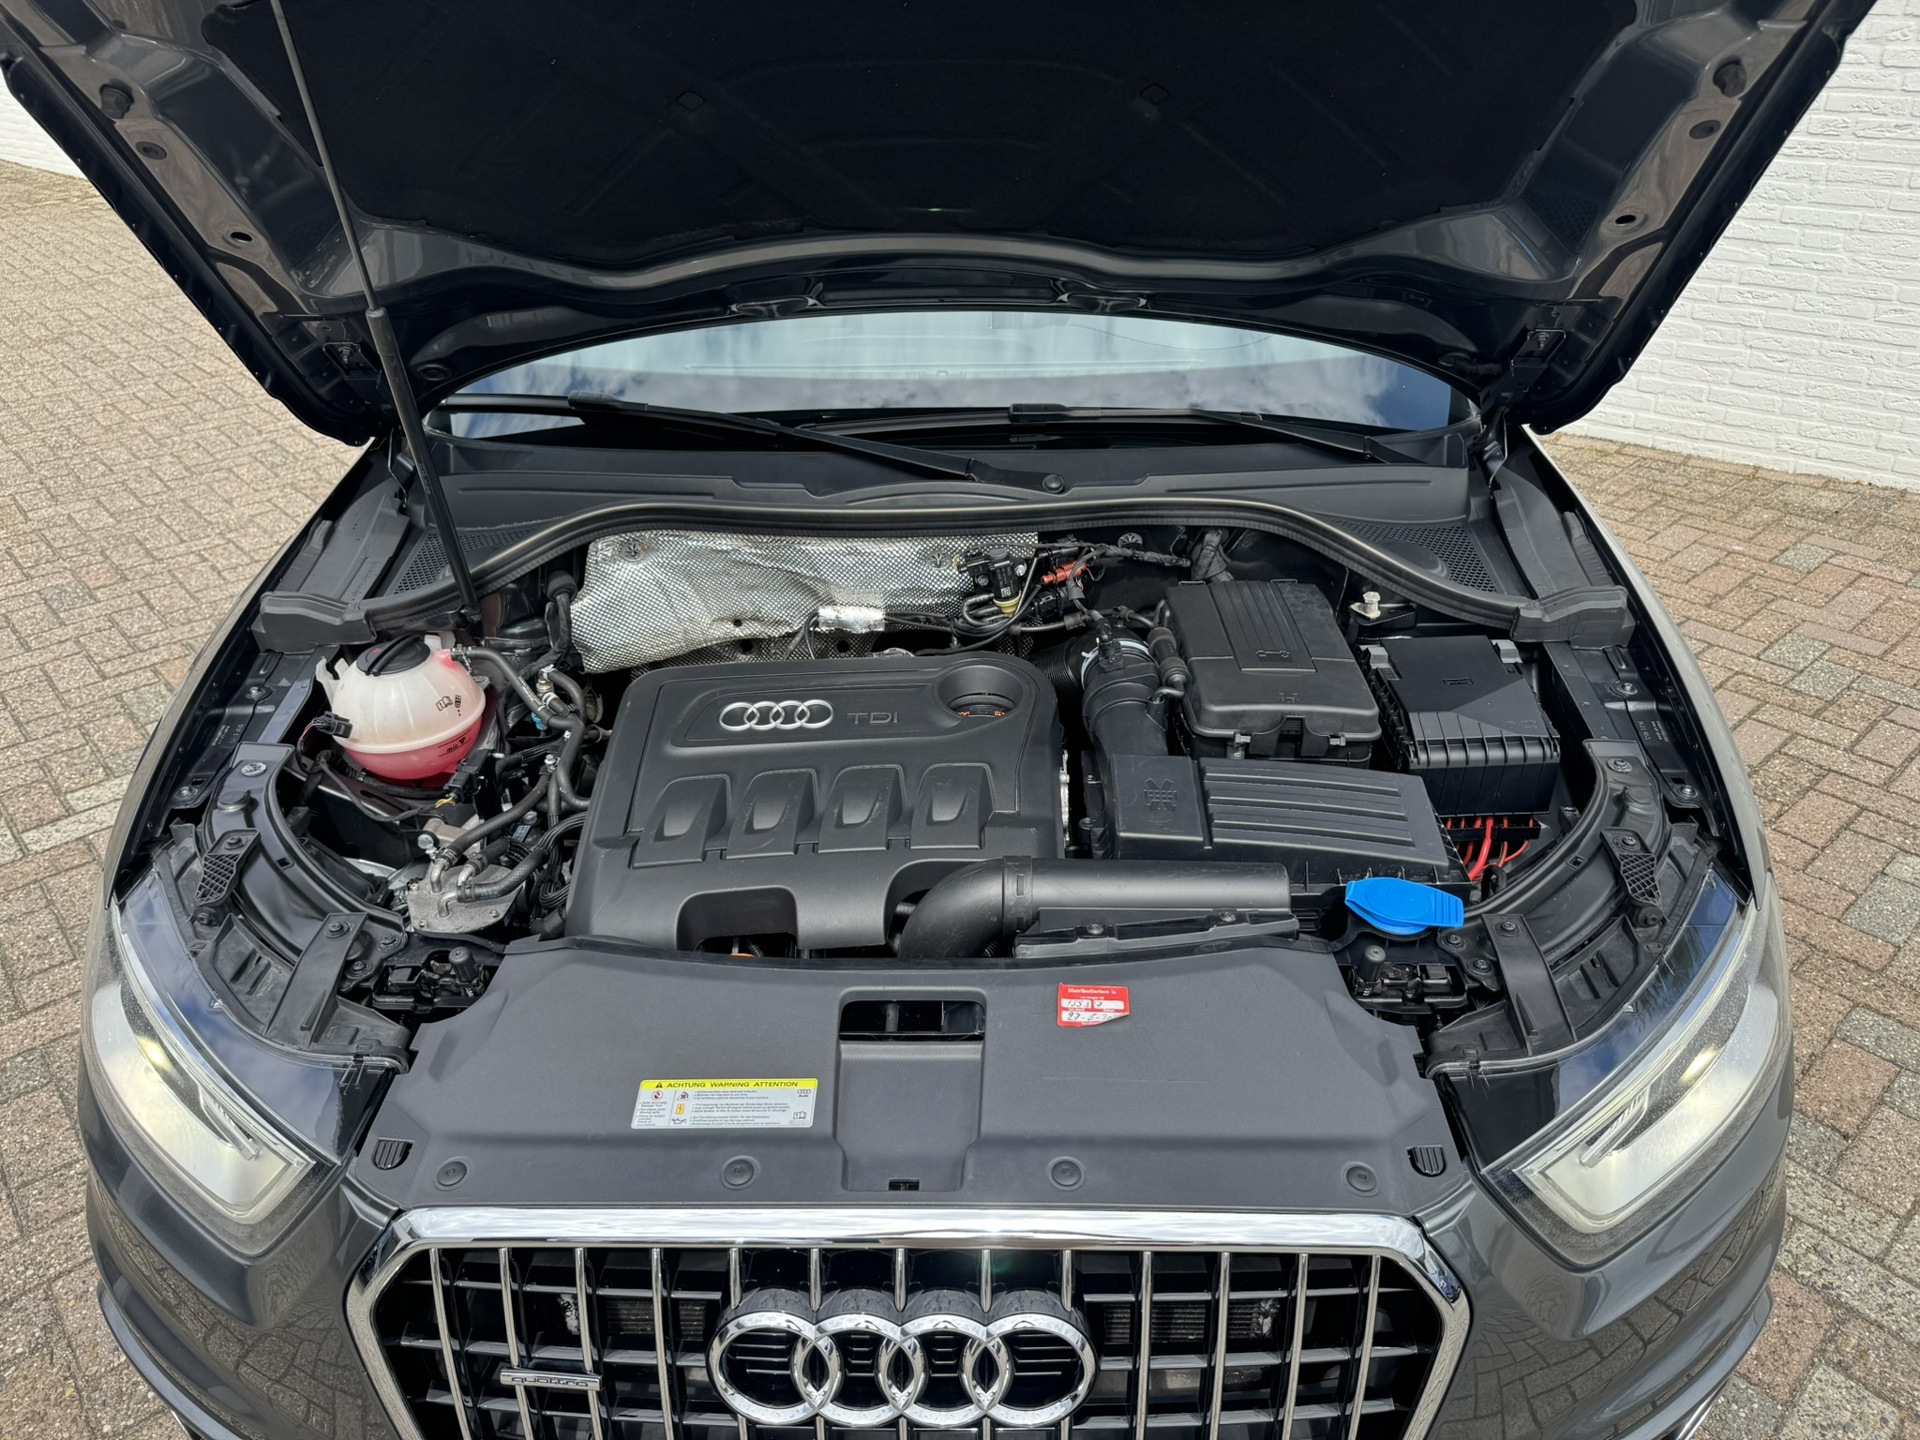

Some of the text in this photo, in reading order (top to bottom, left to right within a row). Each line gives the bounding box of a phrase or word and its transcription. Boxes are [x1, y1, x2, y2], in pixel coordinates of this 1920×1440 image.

[846, 711, 898, 725] TDI
[446, 743, 459, 753] min
[511, 1376, 589, 1388] quattro
